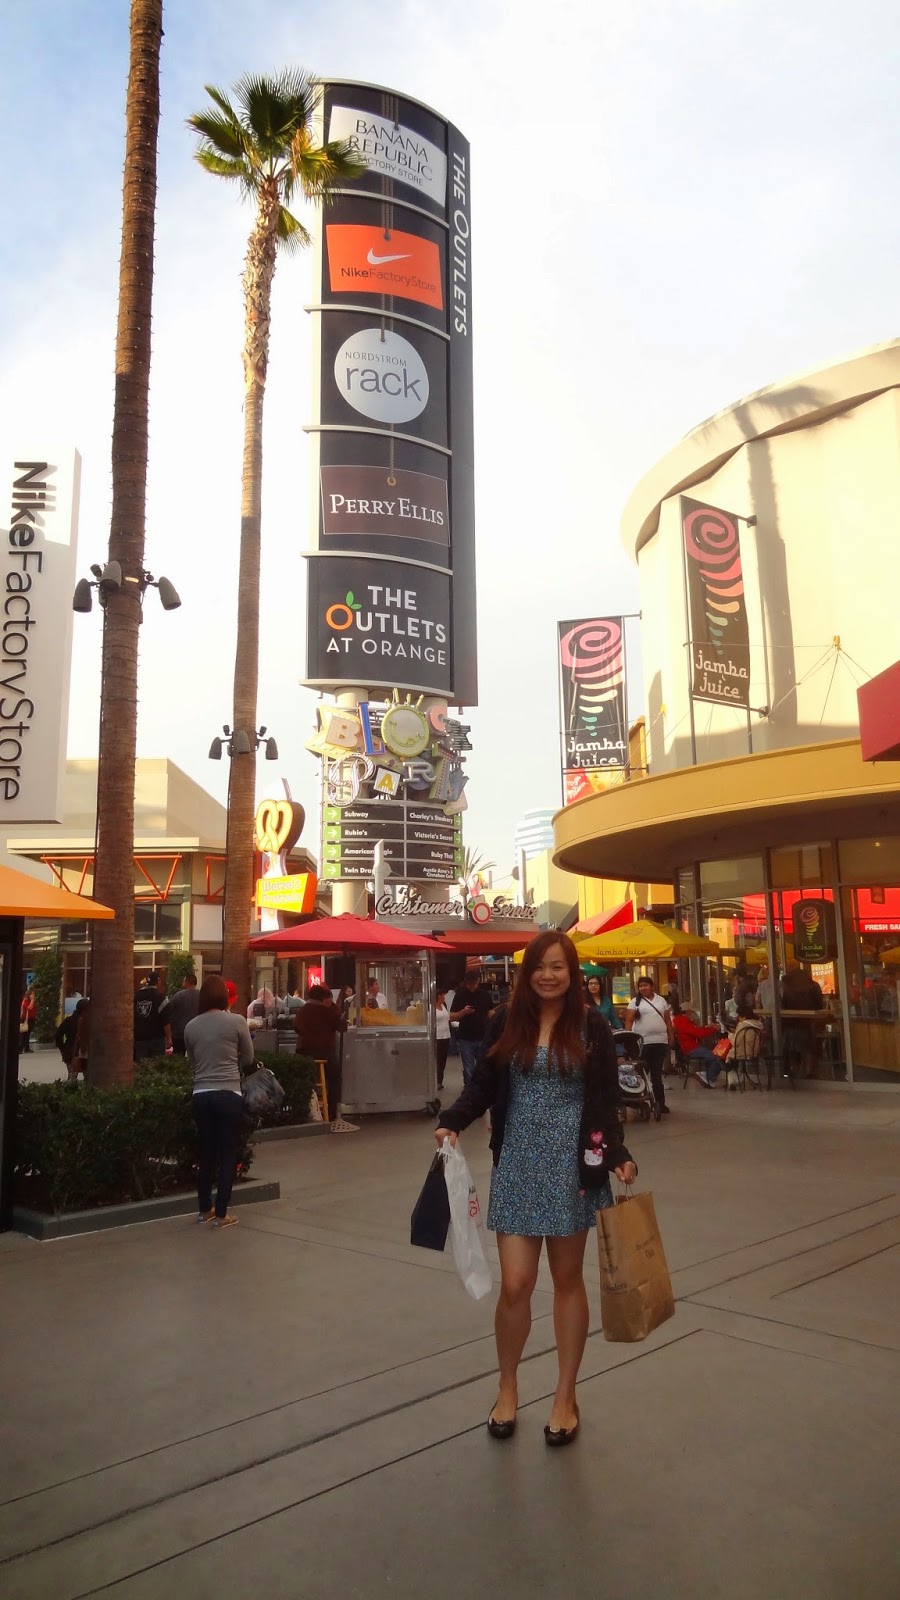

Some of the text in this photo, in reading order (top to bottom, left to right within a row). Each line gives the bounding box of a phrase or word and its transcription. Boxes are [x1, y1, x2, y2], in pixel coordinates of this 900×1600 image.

[355, 119, 429, 163] BANANA
[349, 135, 433, 181] REPUBLIC
[398, 168, 424, 187] STORE
[453, 152, 469, 337] THE OUTLETS
[340, 267, 437, 293] NikeFactoryStore
[345, 351, 408, 368] NORDSTROM
[346, 367, 422, 402] rack
[329, 494, 445, 526] PERRY ELLIS
[367, 585, 418, 611] THE
[0, 461, 49, 801] NikeFactoryStore
[326, 603, 447, 643] OUTLETS
[326, 637, 447, 666] AT ORANGE
[695, 649, 749, 679] jamba
[567, 736, 627, 753] jamba
[344, 811, 369, 819] Subway
[409, 812, 434, 821] Charley's
[414, 831, 439, 840] Victoria's
[430, 851, 443, 860] Ruby
[375, 894, 539, 918] Customer Service
